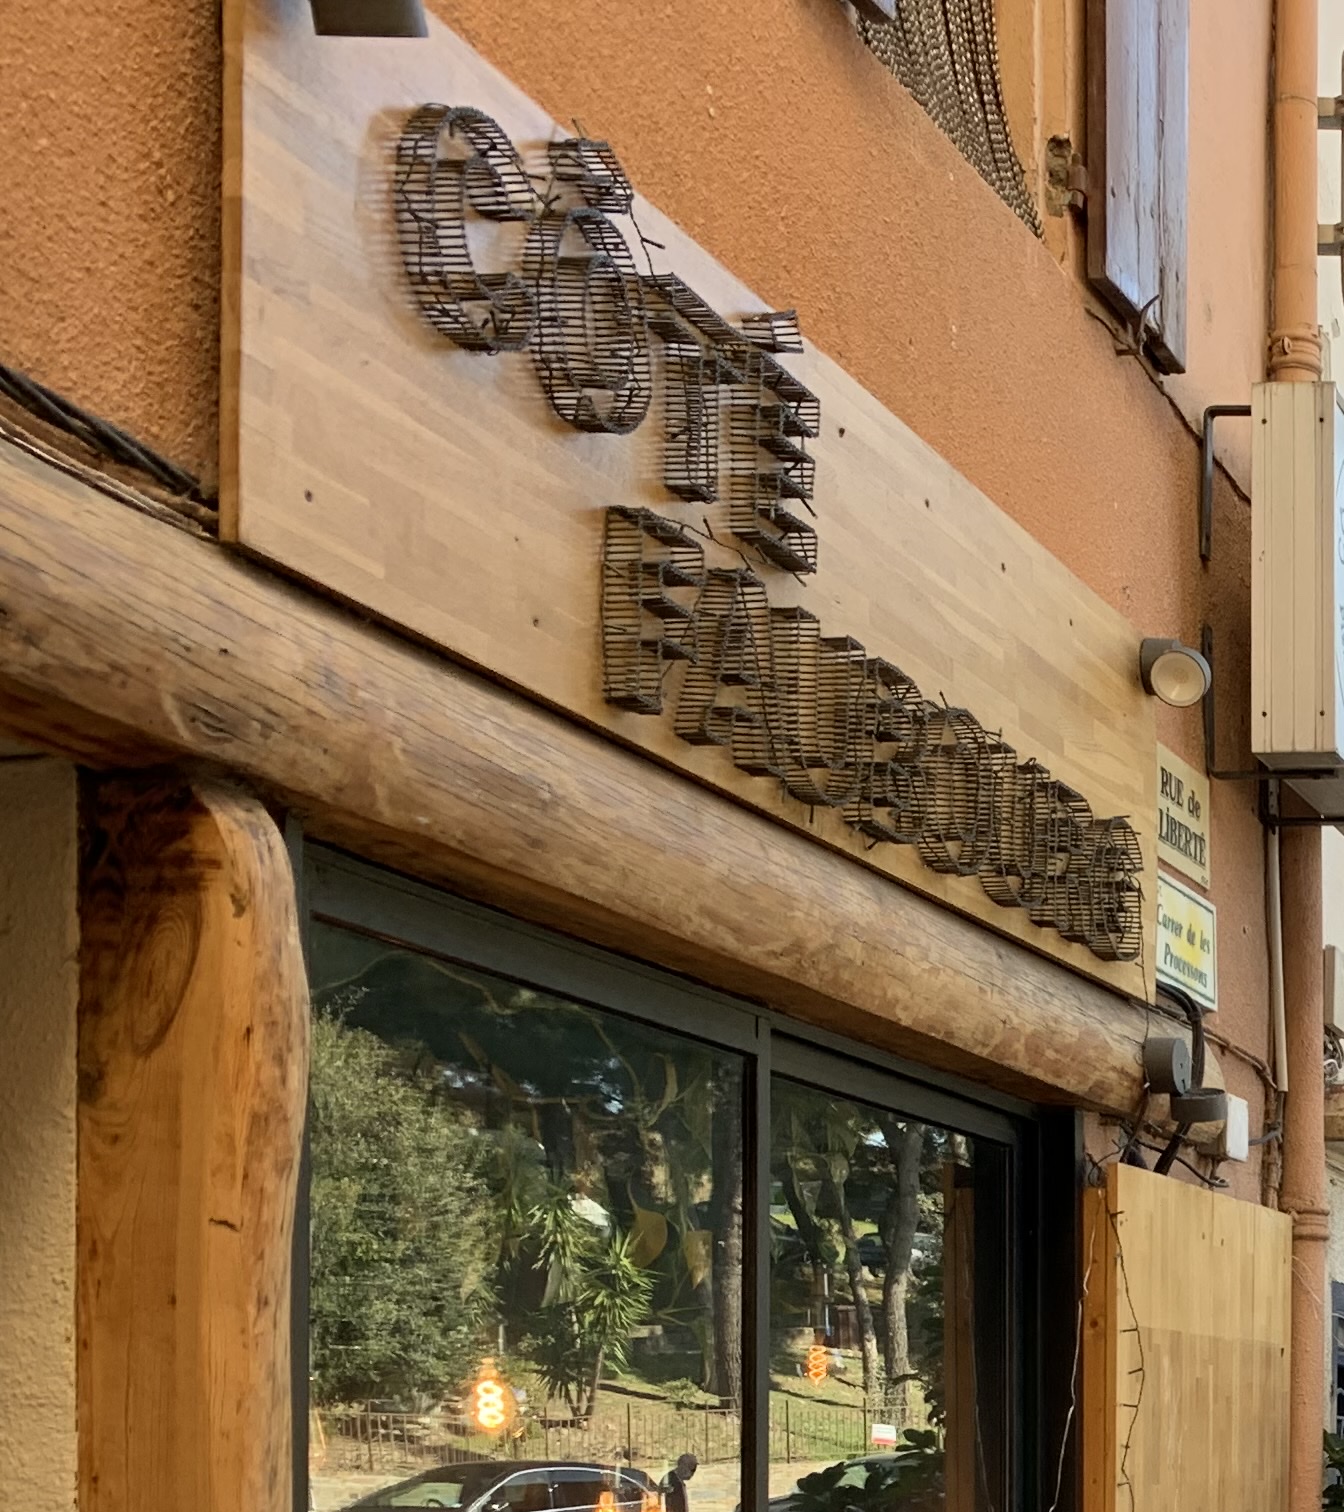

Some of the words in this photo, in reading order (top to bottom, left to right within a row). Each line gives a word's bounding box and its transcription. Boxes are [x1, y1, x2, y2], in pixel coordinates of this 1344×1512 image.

[603, 505, 1143, 961] FAUBOURG
[1160, 766, 1184, 808] RUE
[1187, 789, 1201, 819] de
[1157, 903, 1183, 939] Carrer
[1187, 922, 1196, 947] de
[1199, 930, 1211, 955] les
